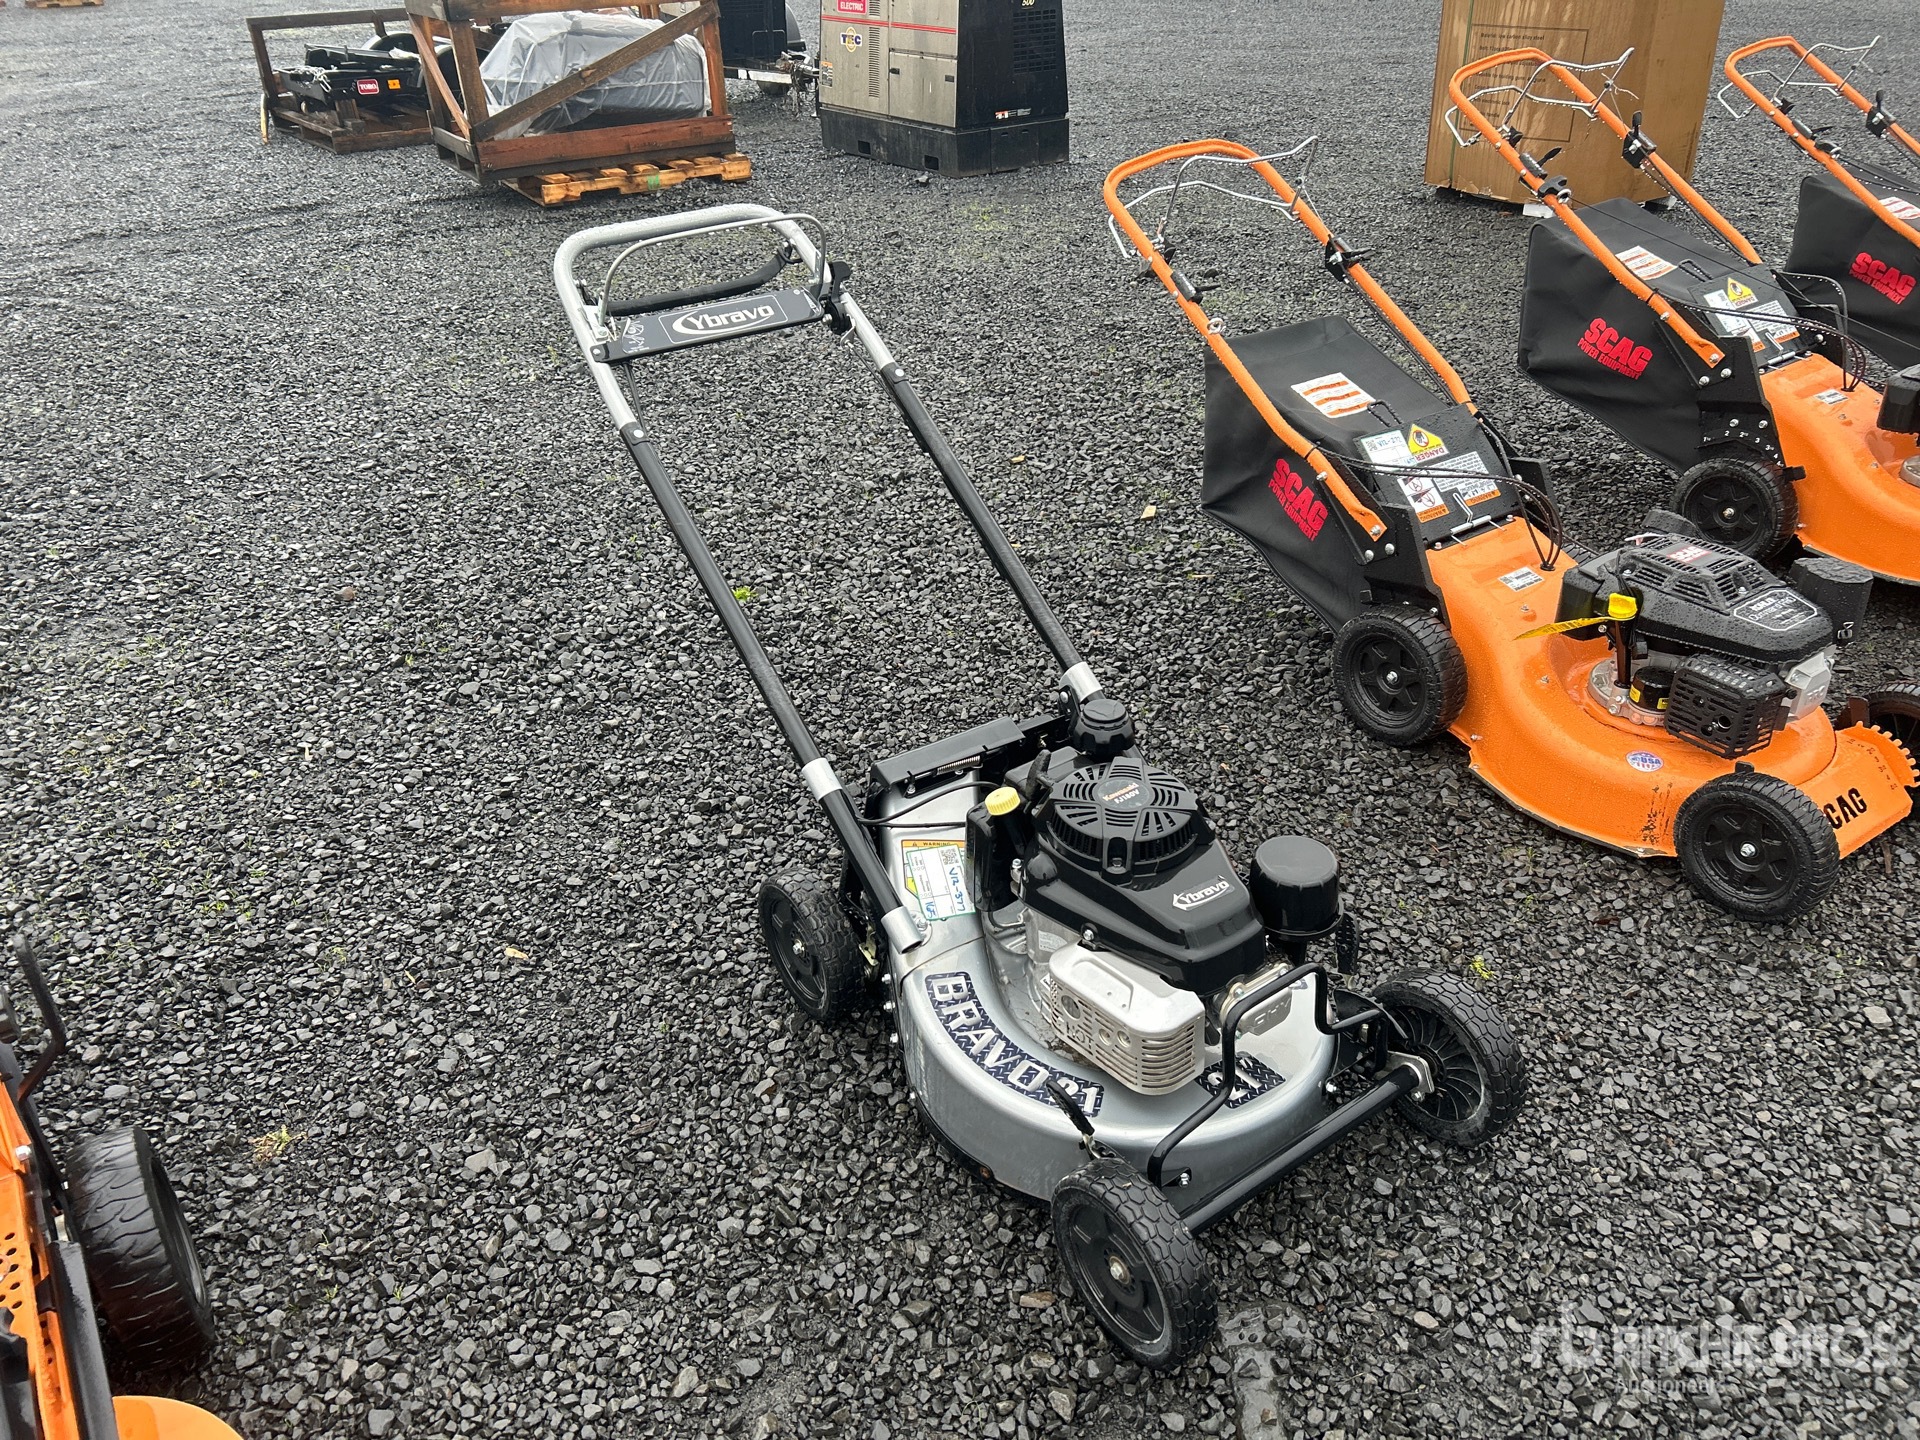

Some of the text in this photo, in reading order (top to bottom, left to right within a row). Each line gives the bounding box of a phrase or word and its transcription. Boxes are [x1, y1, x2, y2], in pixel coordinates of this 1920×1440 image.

[840, 1, 864, 10] ELECTRIC
[1851, 252, 1917, 297] SCAG
[686, 305, 775, 330] Ybravo
[1577, 337, 1642, 380] POWER EQUIPMENT
[1584, 317, 1653, 372] SCAG
[1415, 447, 1445, 461] DANGER
[1268, 479, 1319, 541] POWER EQUIPMENT
[1272, 458, 1329, 531] SCAG
[1114, 789, 1140, 804] FJ180V
[1823, 787, 1868, 829] CAG
[1178, 880, 1230, 905] Ybravo
[931, 975, 1050, 1093] BRAVO
